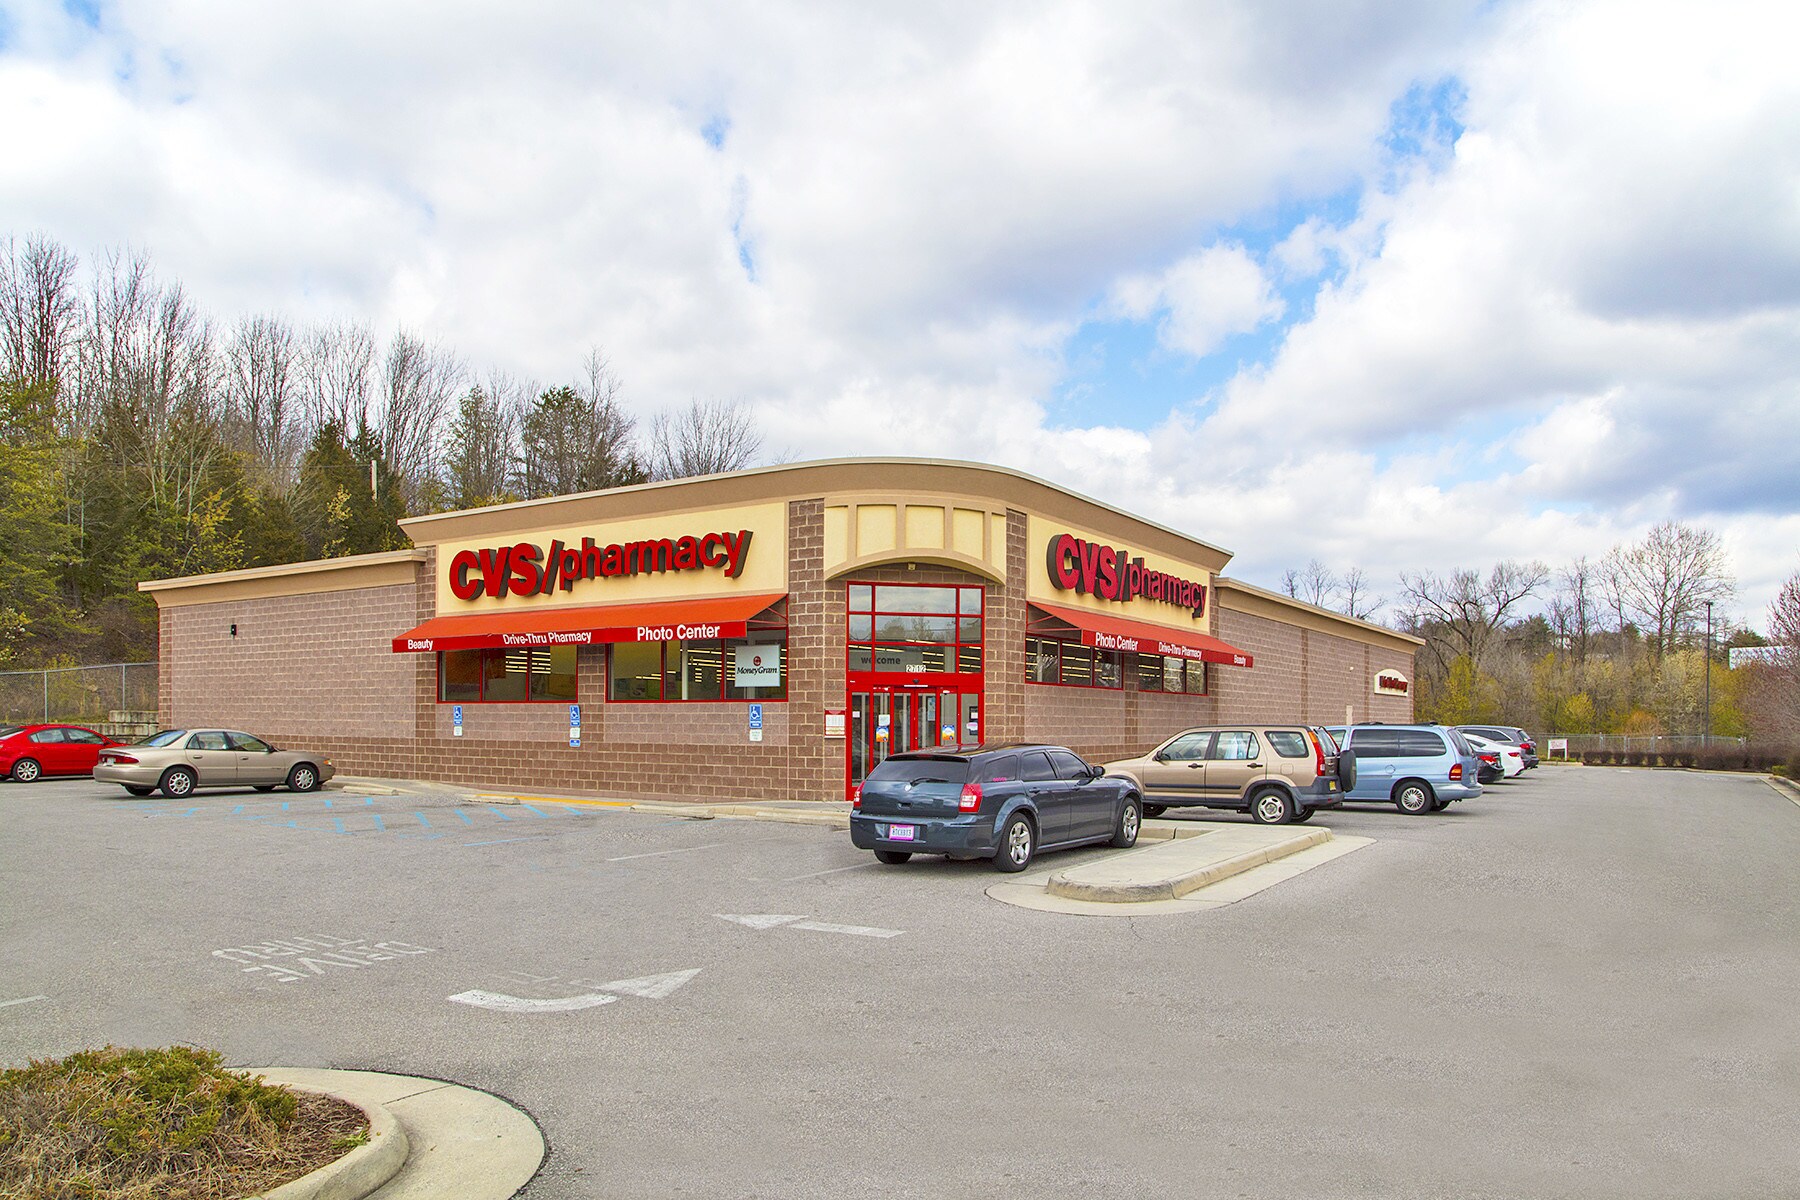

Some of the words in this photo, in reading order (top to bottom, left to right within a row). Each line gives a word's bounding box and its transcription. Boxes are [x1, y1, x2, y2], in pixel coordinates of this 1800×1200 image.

[449, 529, 753, 600] CVS/pharmacy
[1047, 533, 1208, 618] CVS/pharmacy
[502, 633, 547, 645] Drive-Thru
[548, 631, 592, 644] Pharmacy
[637, 626, 673, 641] Photo
[676, 624, 720, 640] Center
[407, 639, 433, 651] Beauty
[1095, 632, 1115, 648] Photo
[1116, 635, 1138, 651] Center
[1158, 641, 1181, 656] Drive-Thru
[1181, 645, 1202, 660] Pharmacy
[861, 656, 901, 665] wecome
[1233, 654, 1247, 667] Beauty
[736, 666, 778, 676] MoneyGram
